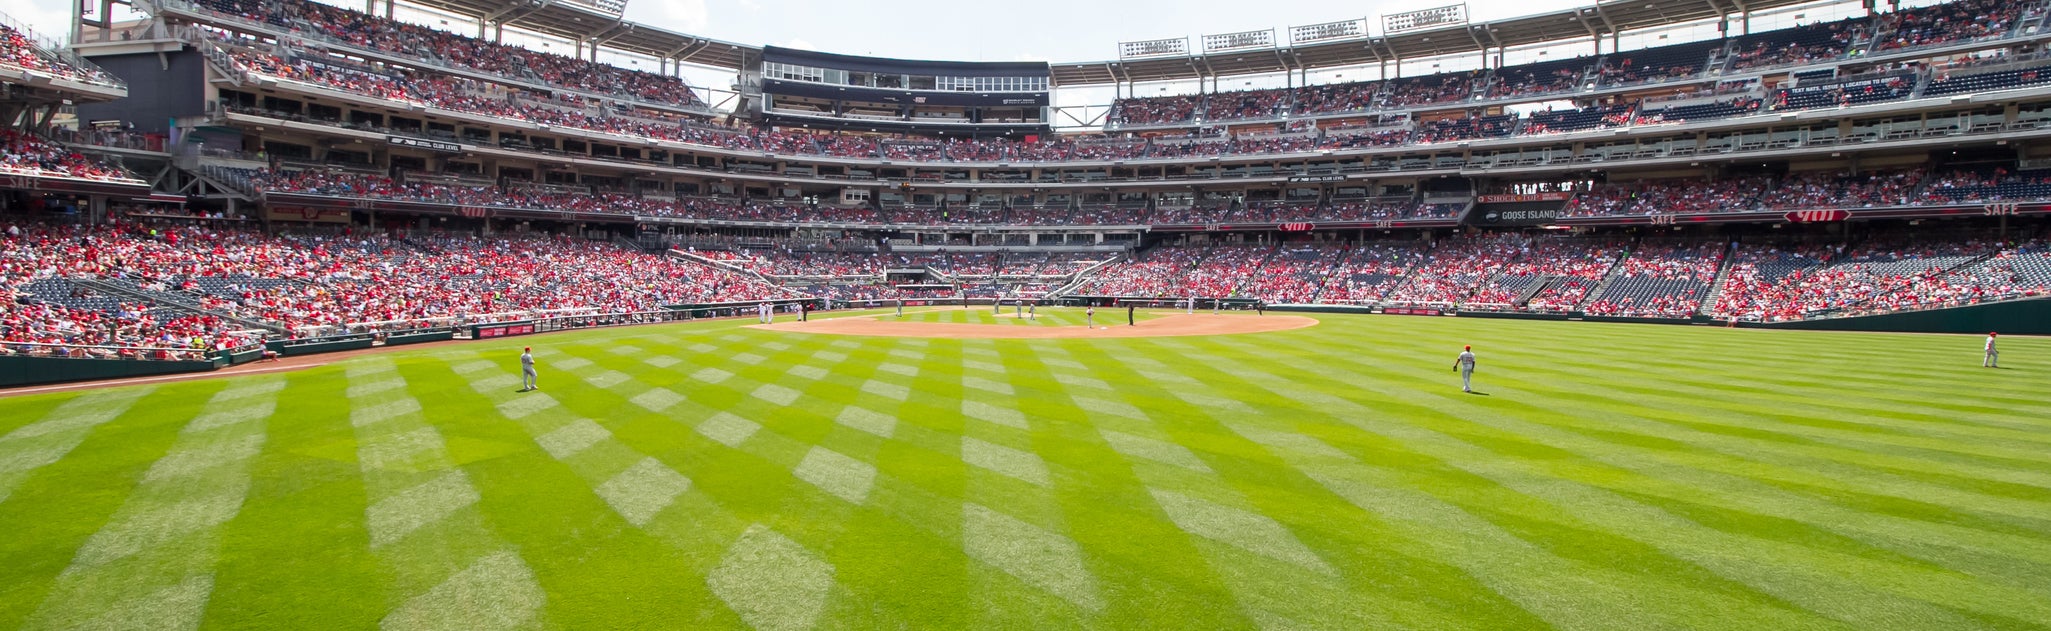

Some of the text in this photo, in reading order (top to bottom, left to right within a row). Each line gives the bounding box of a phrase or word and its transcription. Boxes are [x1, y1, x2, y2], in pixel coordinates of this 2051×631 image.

[1845, 80, 1872, 88] LOCATION
[9, 176, 41, 190] SAFE
[1487, 194, 1517, 203] SHOCK
[1983, 203, 2020, 216] SAFE
[1502, 210, 1556, 220] GOOSE ISLAND
[1650, 214, 1677, 225] SAFE
[1205, 223, 1221, 231] SAFE
[1376, 220, 1392, 228] SAFE
